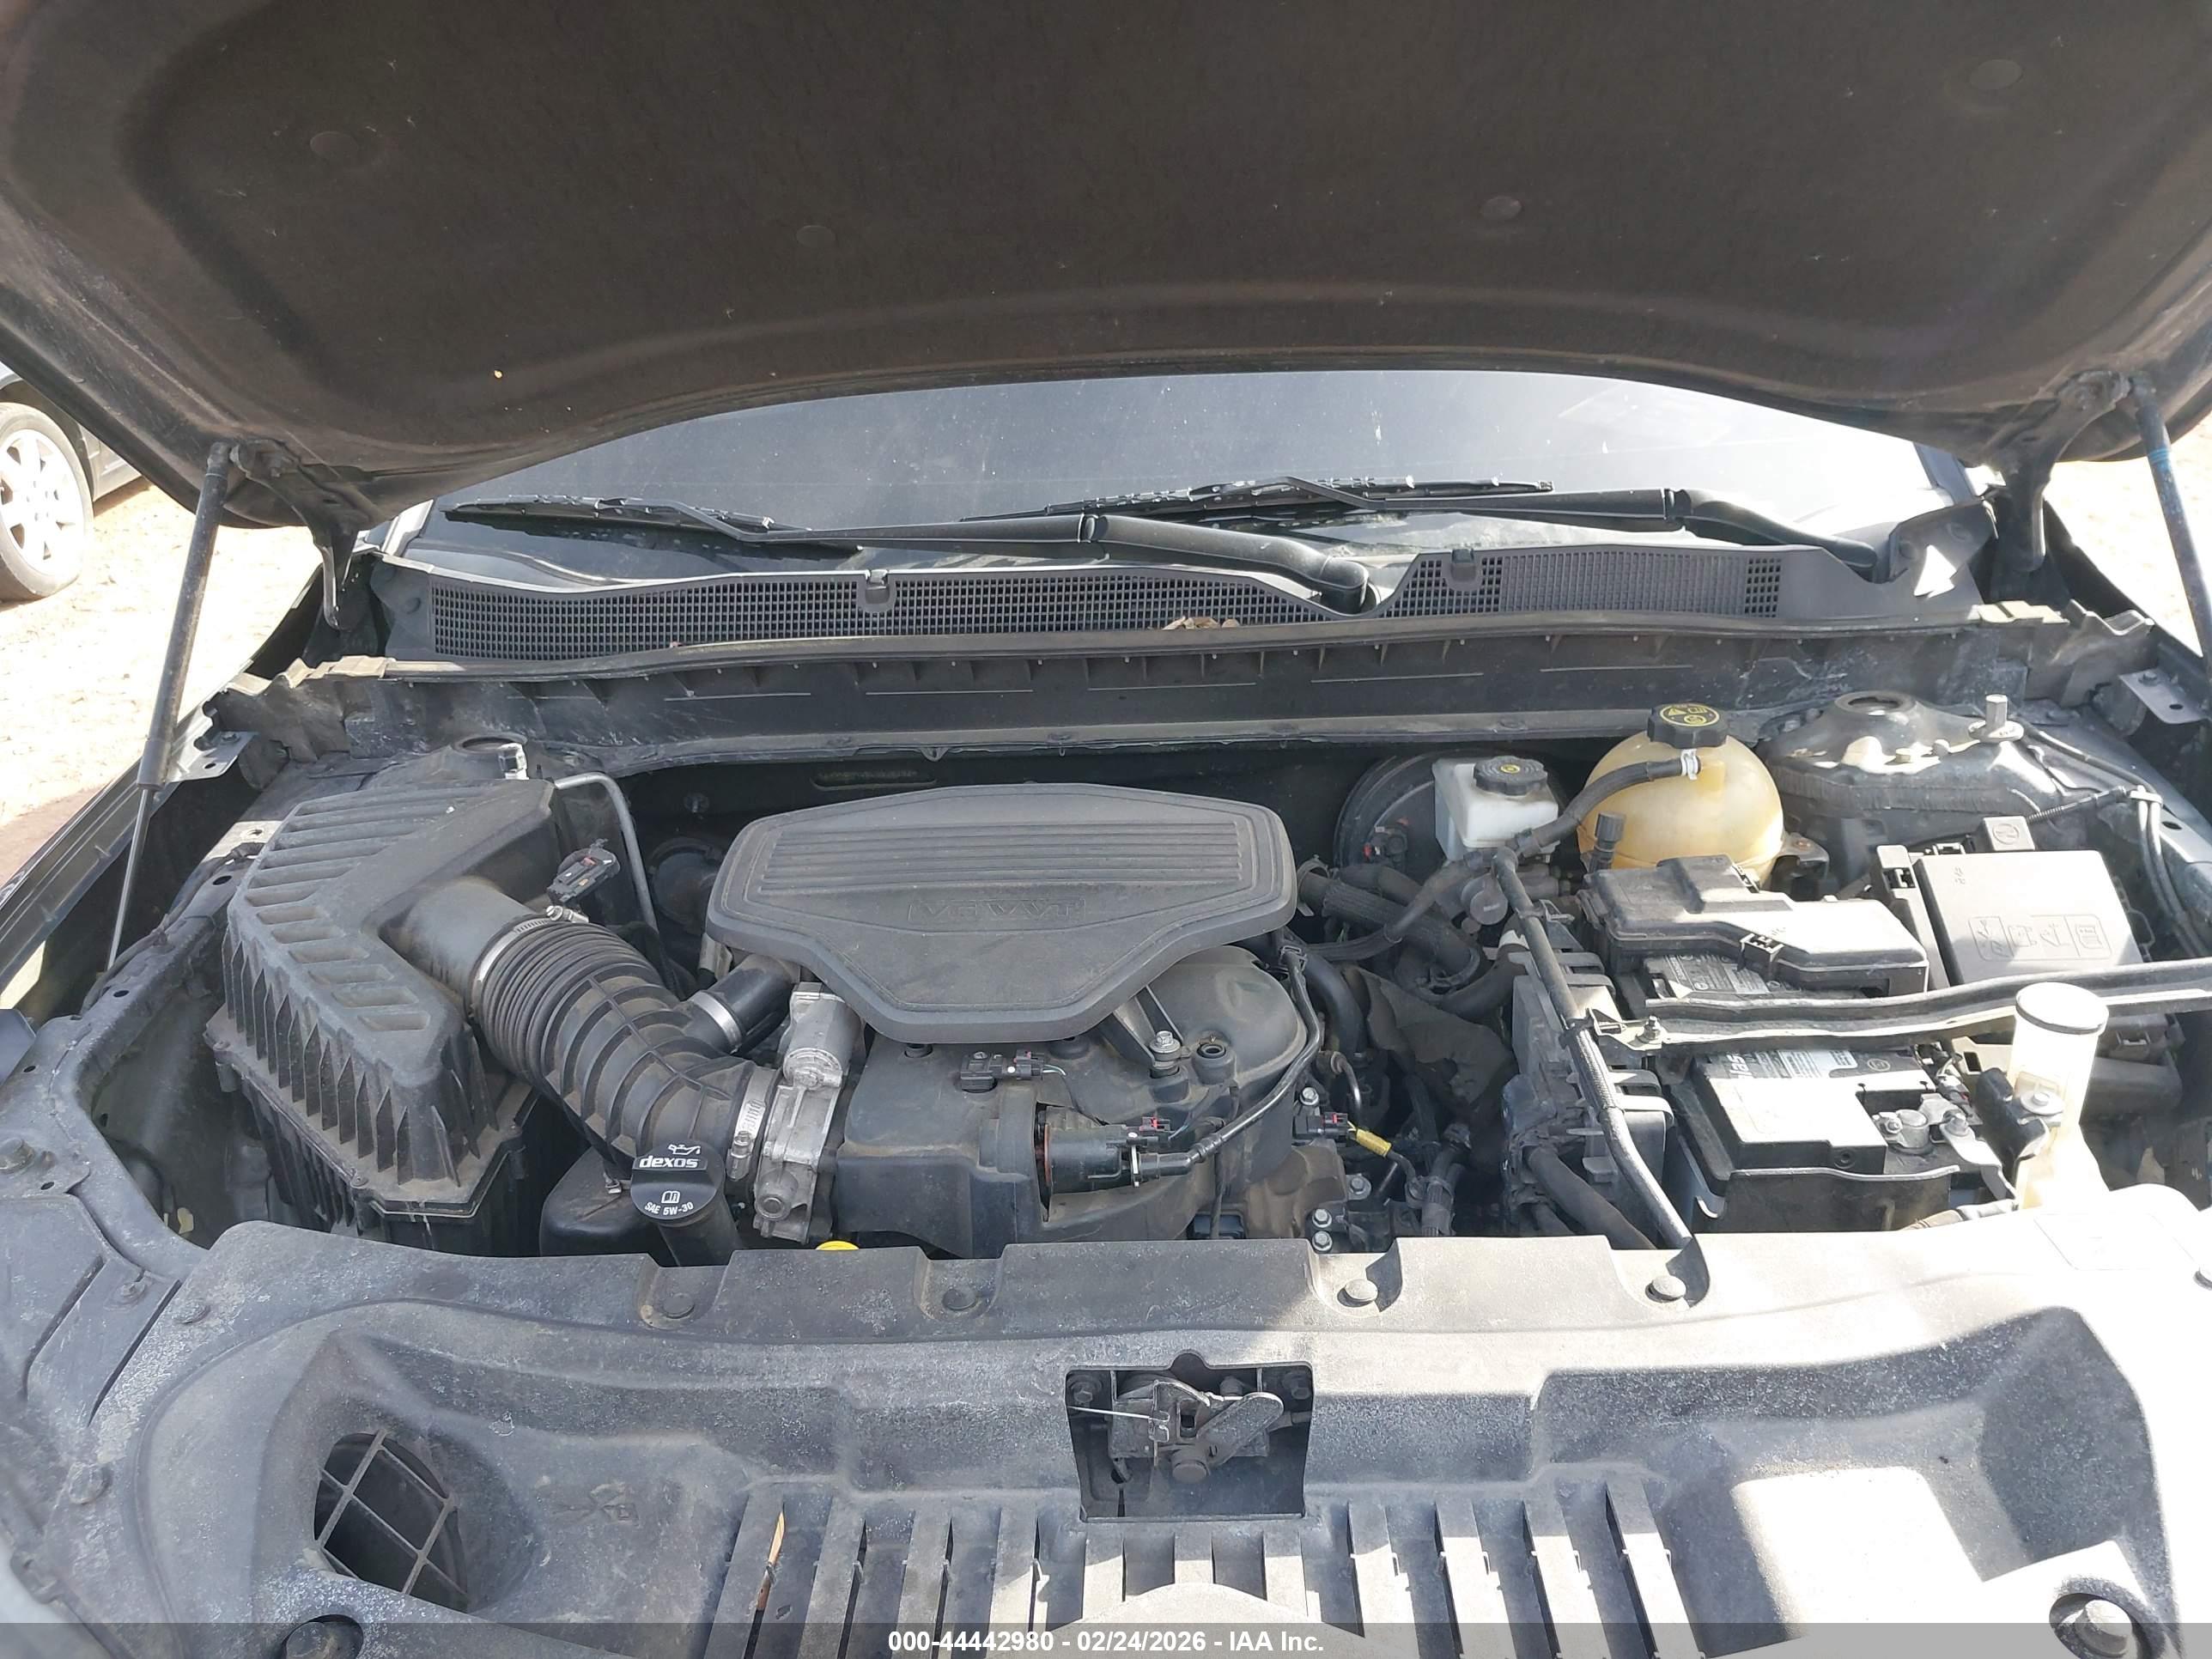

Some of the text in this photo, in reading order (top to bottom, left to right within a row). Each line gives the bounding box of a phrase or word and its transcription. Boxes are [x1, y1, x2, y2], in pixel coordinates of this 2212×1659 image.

[639, 1156, 699, 1168] dexos
[645, 1202, 694, 1215] SAE 5W-30
